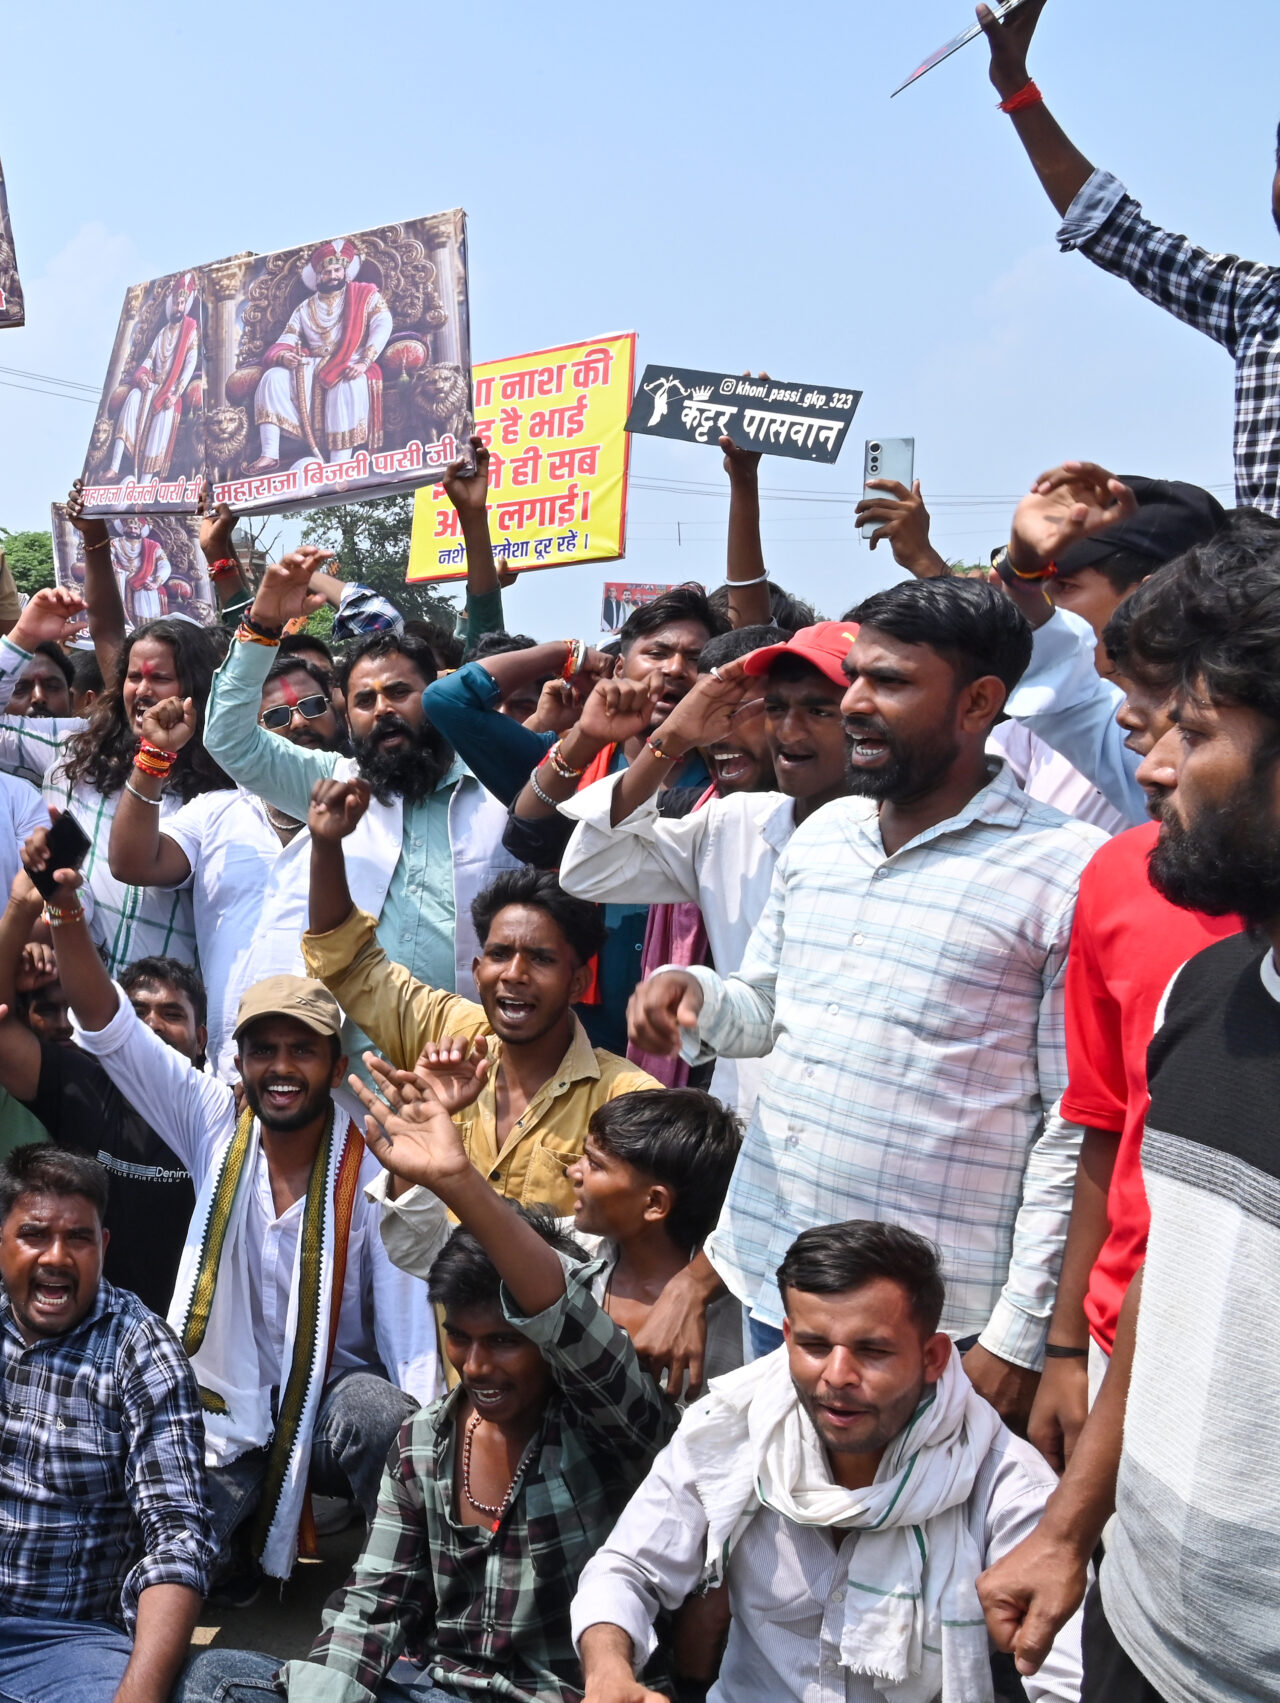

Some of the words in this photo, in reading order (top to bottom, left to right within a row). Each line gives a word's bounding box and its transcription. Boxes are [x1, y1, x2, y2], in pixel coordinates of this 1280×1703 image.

[499, 364, 567, 400] नाश
[571, 347, 614, 389] की
[735, 380, 854, 410] khoni_passi_gkp_323
[499, 406, 523, 445] है
[529, 394, 588, 439] भाई
[743, 408, 845, 452] पासवान
[212, 471, 299, 504] महाराजा
[302, 450, 370, 488] बिजली
[373, 440, 423, 474] पासी
[426, 433, 457, 466] जी
[510, 446, 543, 486] ही
[547, 445, 602, 481] सब
[81, 485, 123, 507] महाराजा
[122, 477, 159, 504] बिजली
[158, 475, 186, 503] पासी
[185, 474, 203, 502] जी
[438, 542, 466, 564] नशे
[534, 535, 554, 560] दूर
[557, 529, 578, 553] रहें
